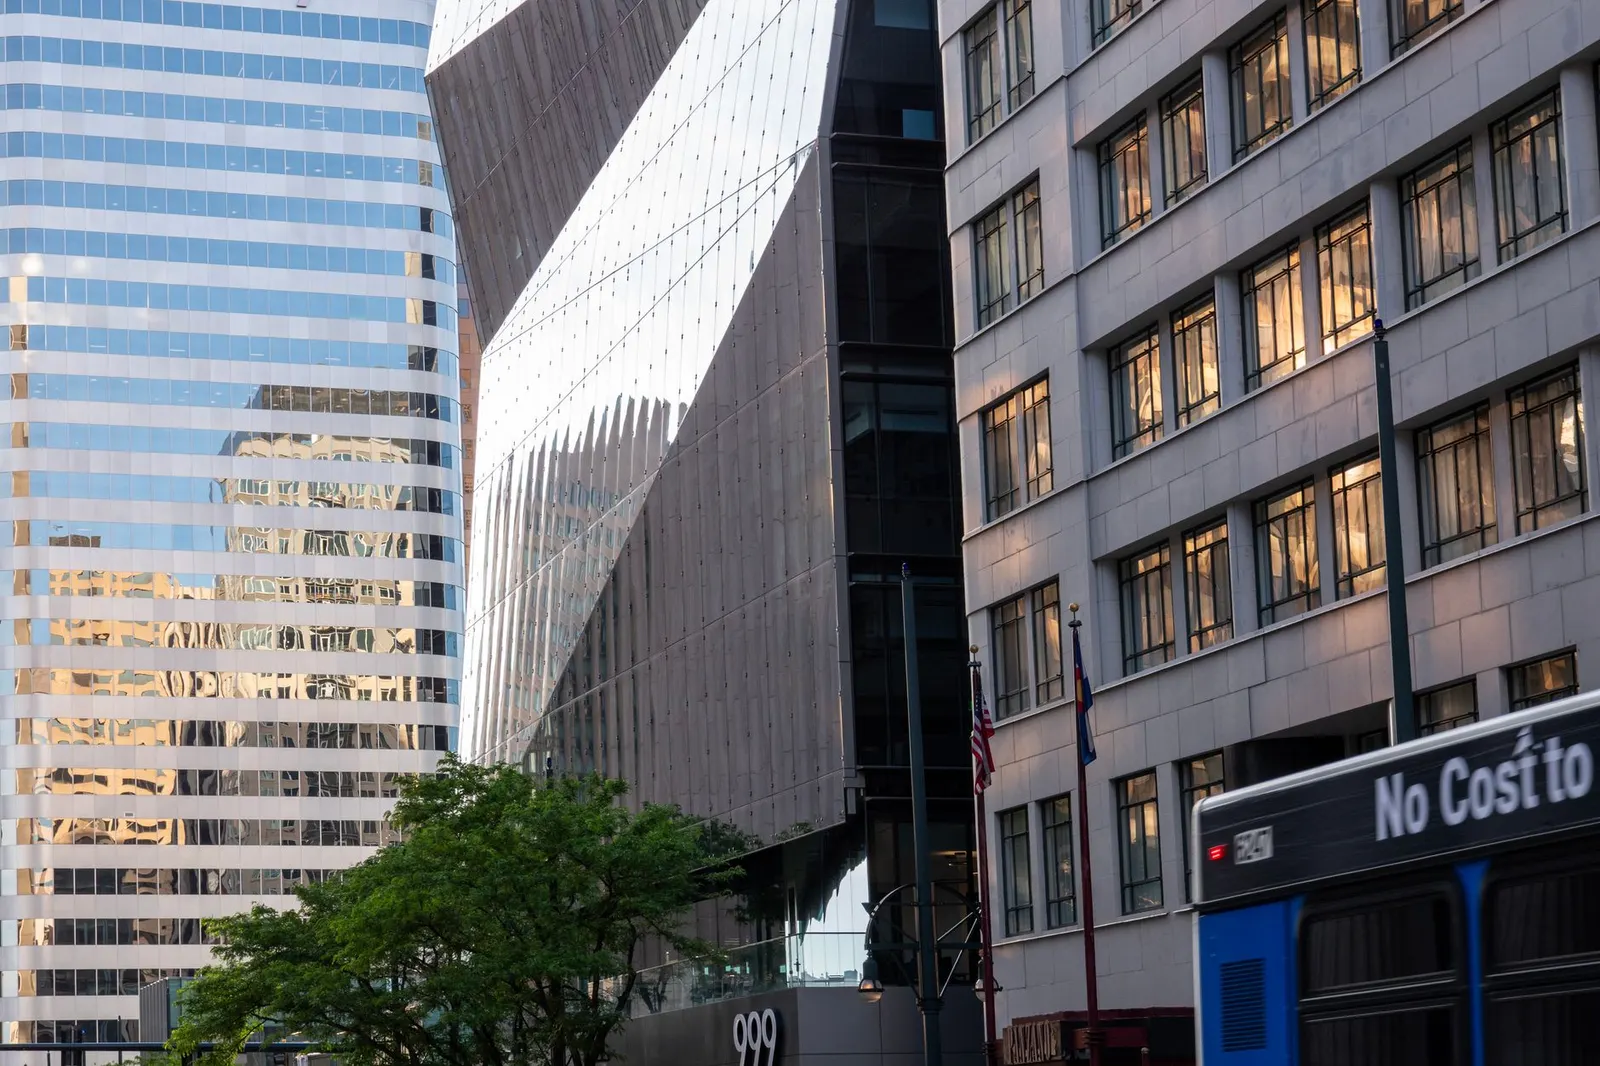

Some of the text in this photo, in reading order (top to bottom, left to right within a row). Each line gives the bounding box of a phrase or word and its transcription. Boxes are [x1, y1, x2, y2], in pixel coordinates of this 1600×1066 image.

[1375, 772, 1429, 841] No
[1542, 736, 1594, 804] to
[733, 1008, 777, 1066] 999
